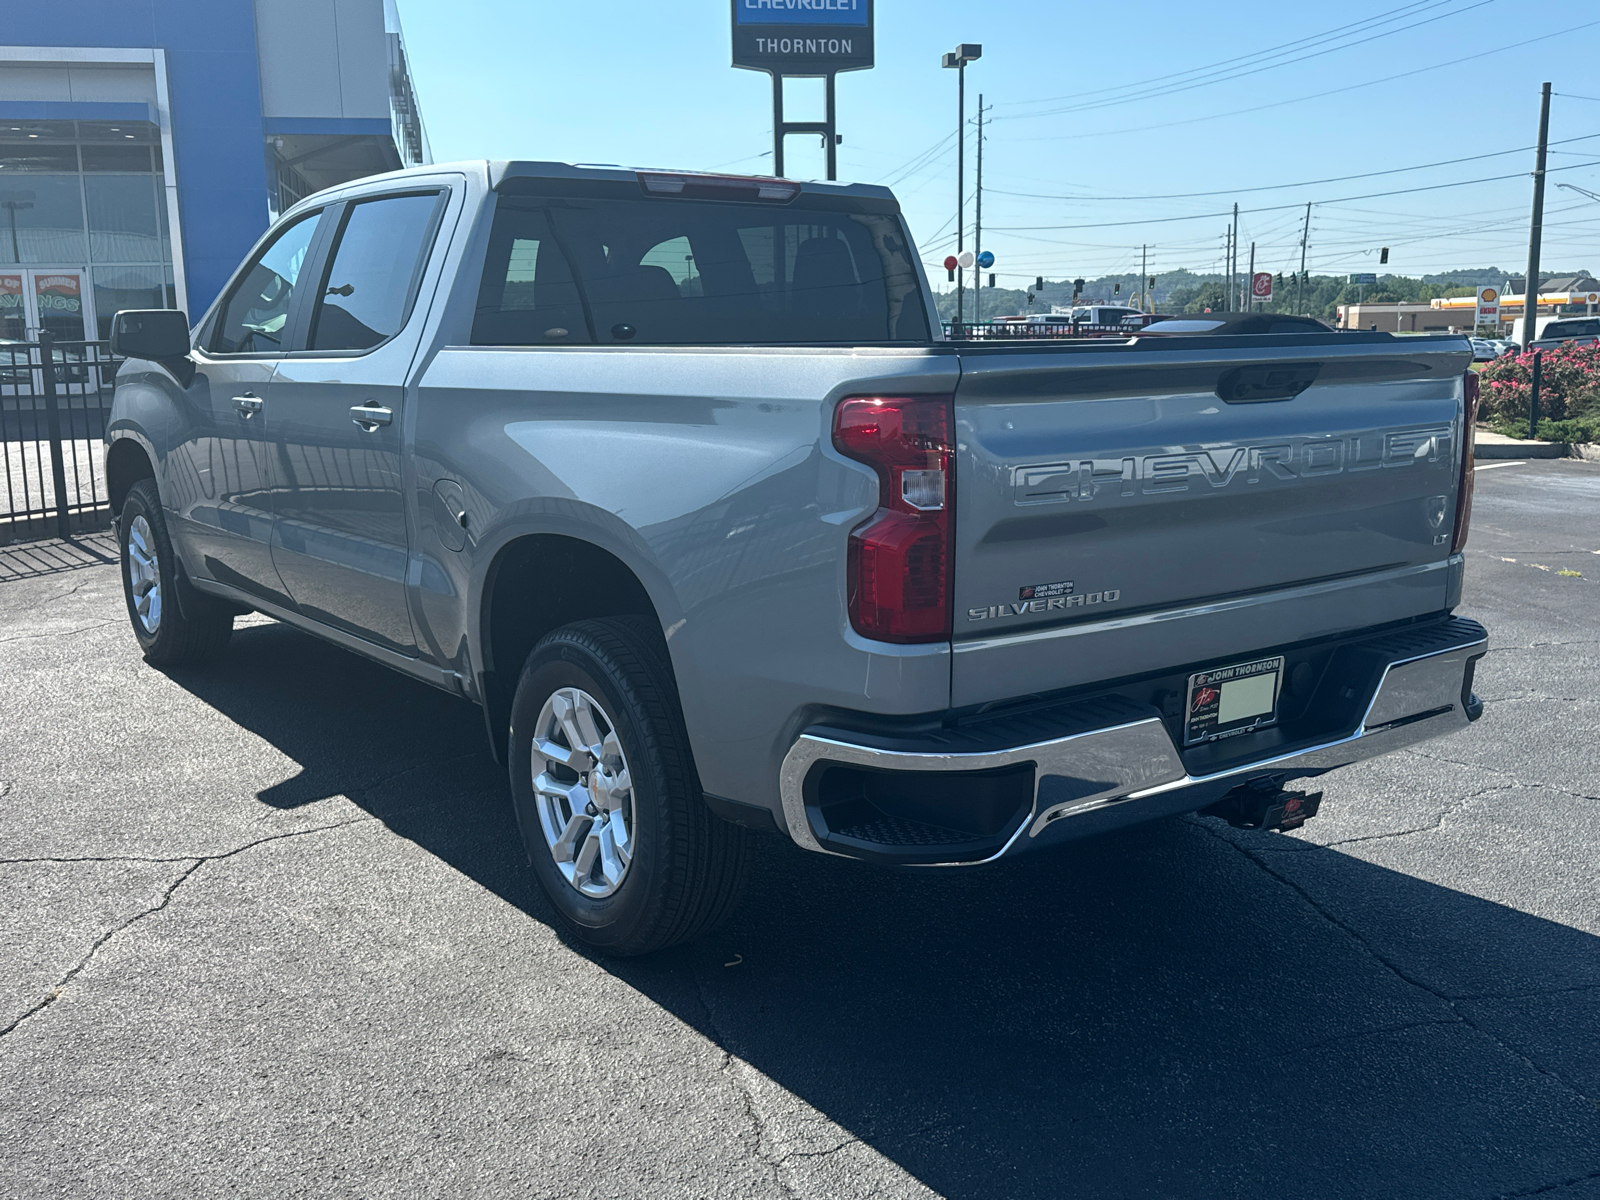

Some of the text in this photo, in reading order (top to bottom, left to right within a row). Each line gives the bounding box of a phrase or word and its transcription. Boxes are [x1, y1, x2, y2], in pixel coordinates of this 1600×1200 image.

[745, 0, 857, 10] CHEVROLET
[756, 38, 852, 54] THORNTON
[39, 276, 77, 290] SUMMER
[1013, 426, 1453, 507] CHEVROLET
[1432, 534, 1448, 545] LT
[1034, 588, 1064, 598] CHEVROLET
[1035, 581, 1074, 592] JOHN THORNTON
[968, 589, 1120, 622] SILVERADO
[1211, 659, 1279, 682] JOHN THORNTON
